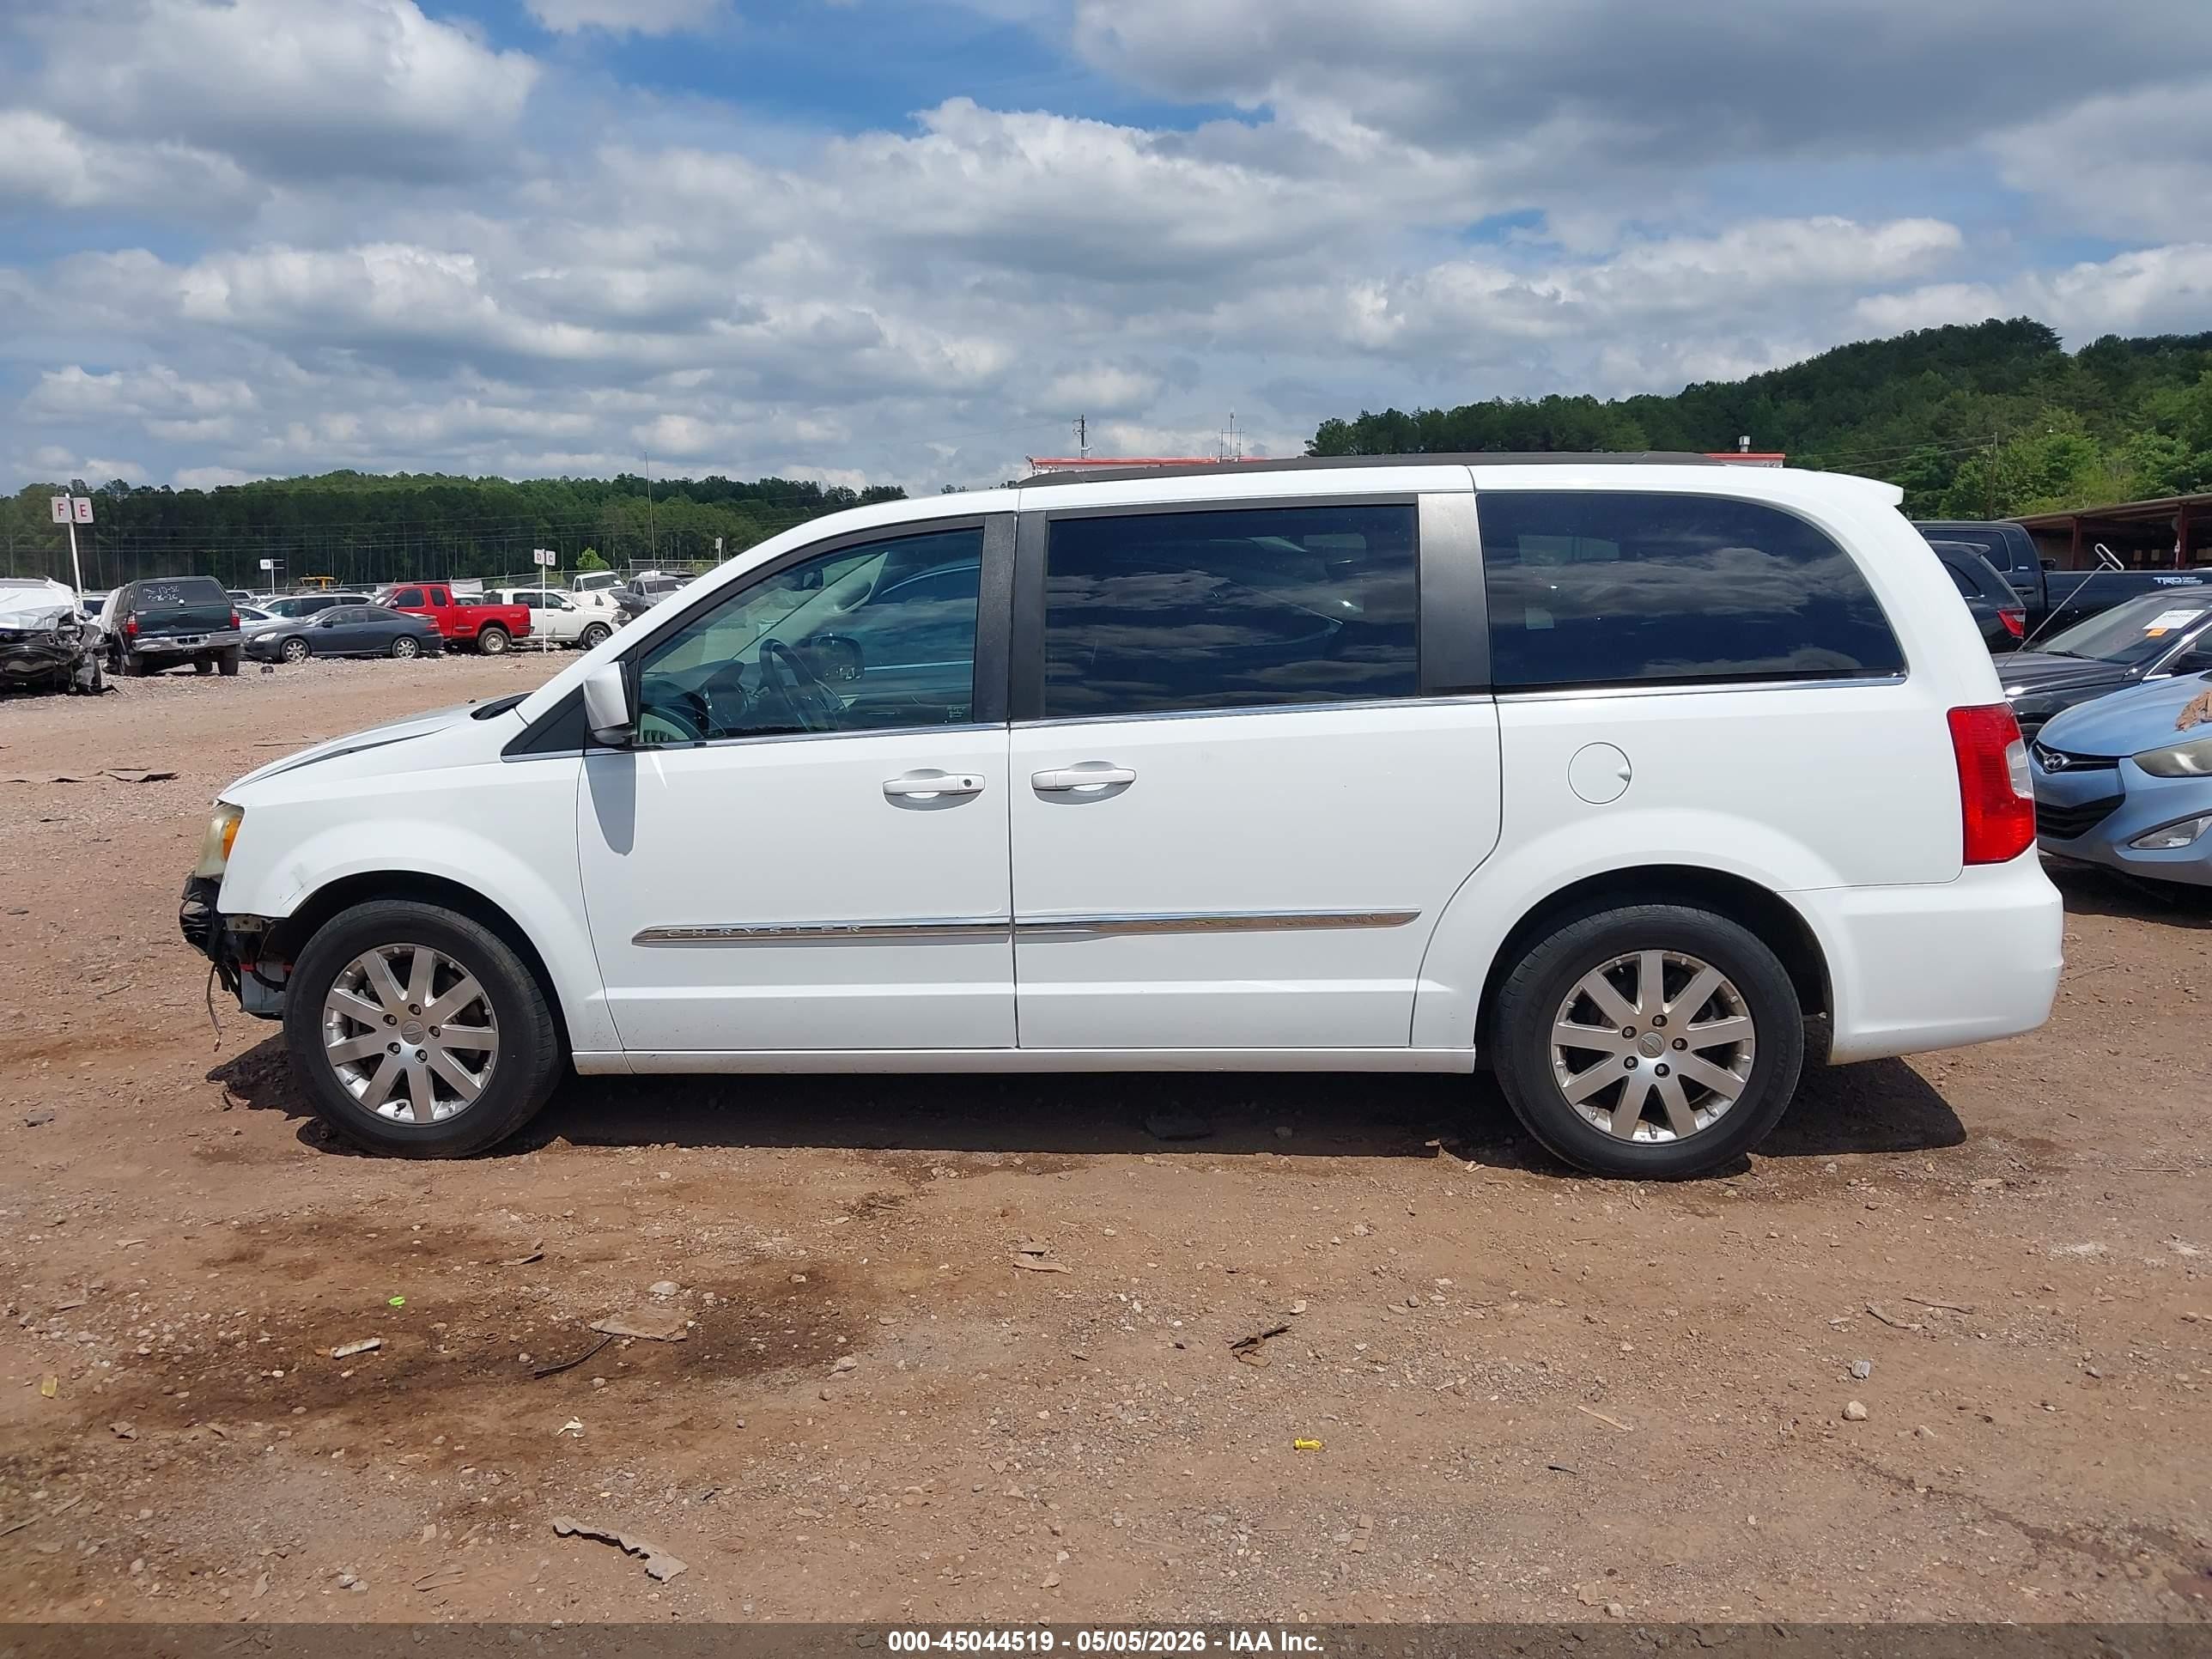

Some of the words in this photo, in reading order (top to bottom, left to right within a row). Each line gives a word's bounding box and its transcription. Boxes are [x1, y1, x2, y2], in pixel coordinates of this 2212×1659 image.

[58, 502, 64, 517] F
[79, 504, 88, 518] E
[548, 554, 553, 562] C
[2153, 576, 2182, 585] TRD
[665, 924, 860, 937] CHRYSLER
